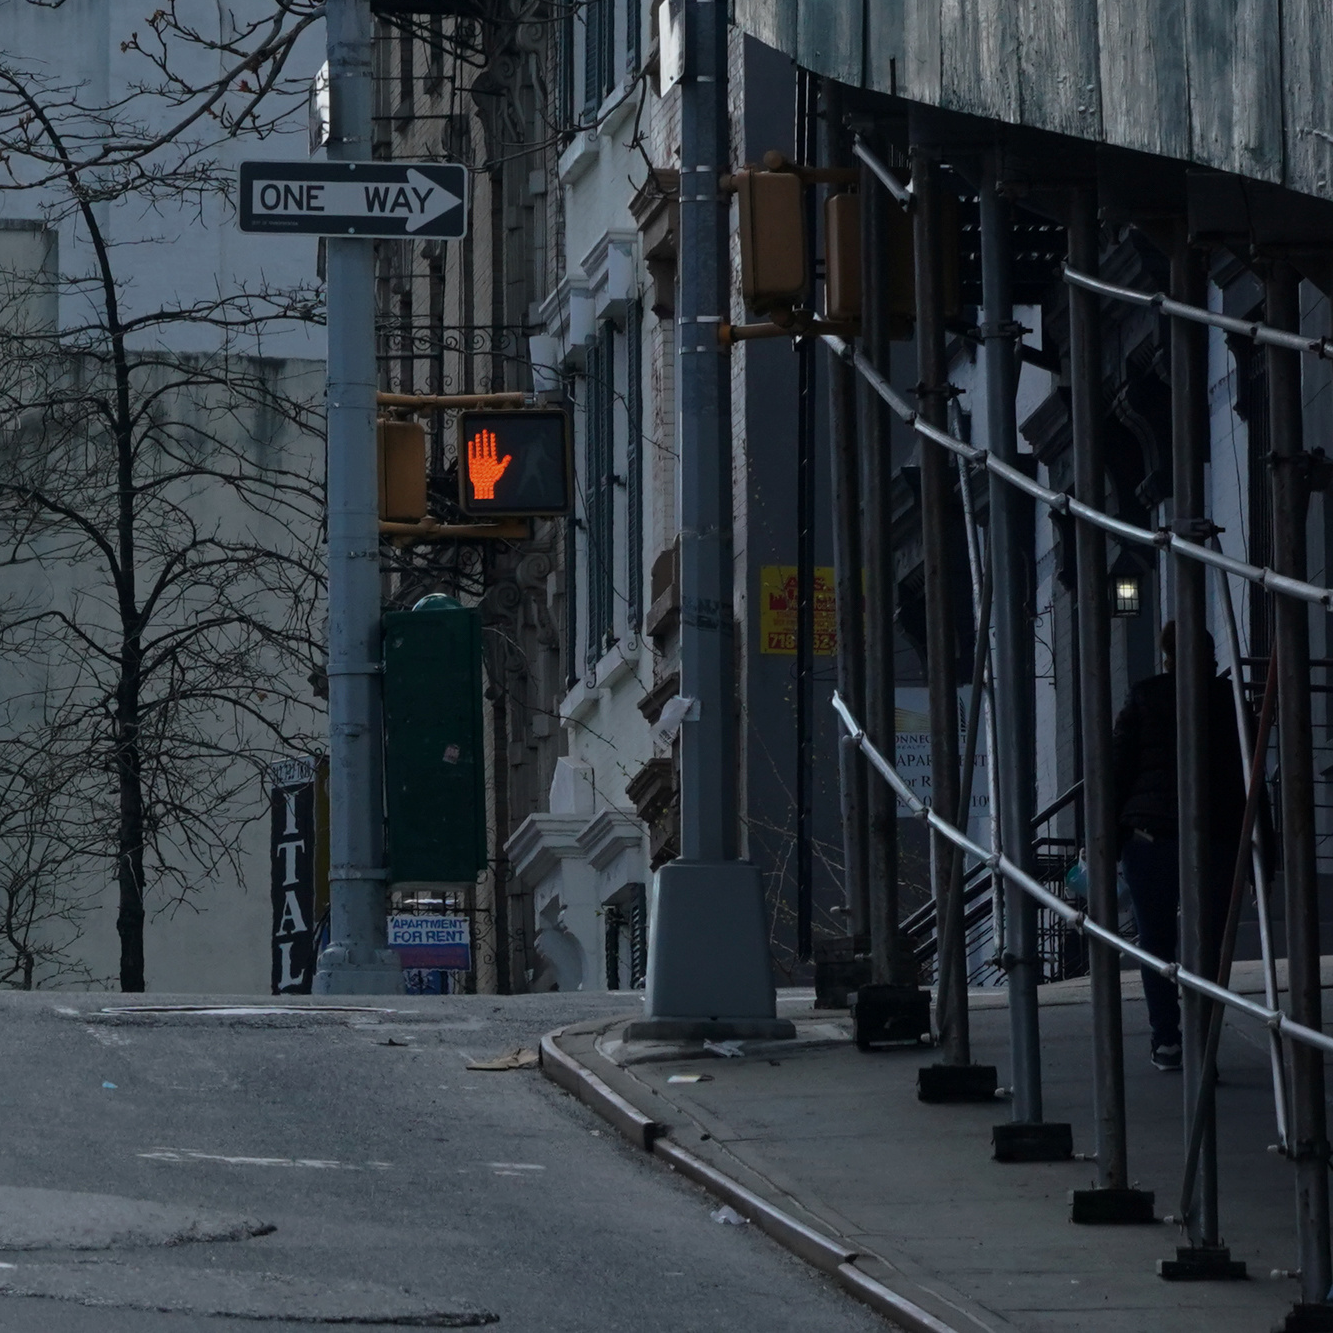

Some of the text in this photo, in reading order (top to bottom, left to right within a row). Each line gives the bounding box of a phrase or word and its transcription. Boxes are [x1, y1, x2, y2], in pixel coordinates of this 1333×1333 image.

[260, 183, 435, 214] ONE WAY
[393, 918, 464, 929] APARTMENT
[393, 930, 465, 943] FOR RENT
